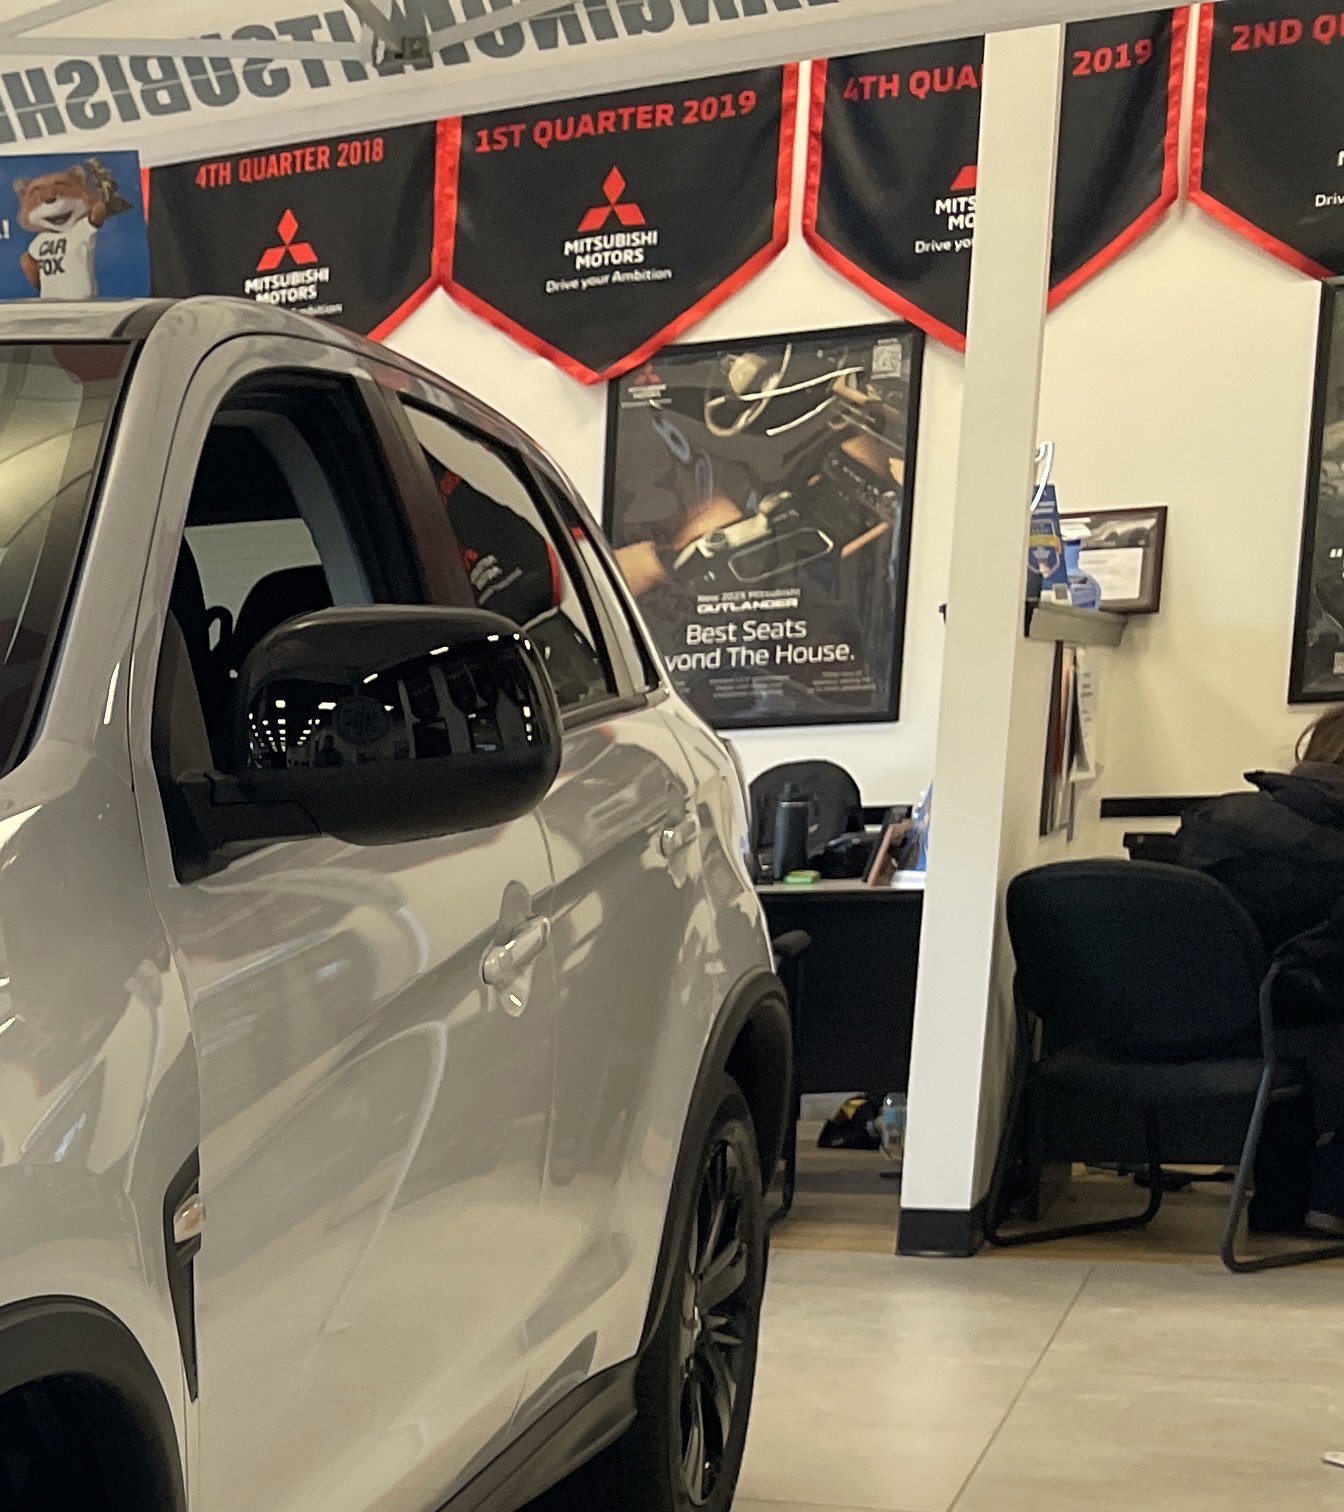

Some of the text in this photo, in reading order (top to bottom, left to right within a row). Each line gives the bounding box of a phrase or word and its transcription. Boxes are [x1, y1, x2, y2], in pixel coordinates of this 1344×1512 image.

[1231, 12, 1344, 52] 2ND Q
[843, 38, 1153, 101] 4TH QUA 2019
[475, 89, 758, 153] 1ST QUARTER 2019
[195, 136, 385, 189] 4TH QUARTER 2018
[563, 230, 658, 256] MITSUBISHI
[914, 240, 950, 255] Drive
[575, 248, 645, 271] MOTORS
[244, 266, 330, 294] MITSUBISHI
[544, 267, 673, 294] Drive your Ambition
[255, 284, 318, 305] MOTORS
[697, 598, 798, 615] OUTLANDER
[686, 619, 807, 646] Best Seats
[726, 645, 770, 667] The
[775, 642, 855, 665] House.
